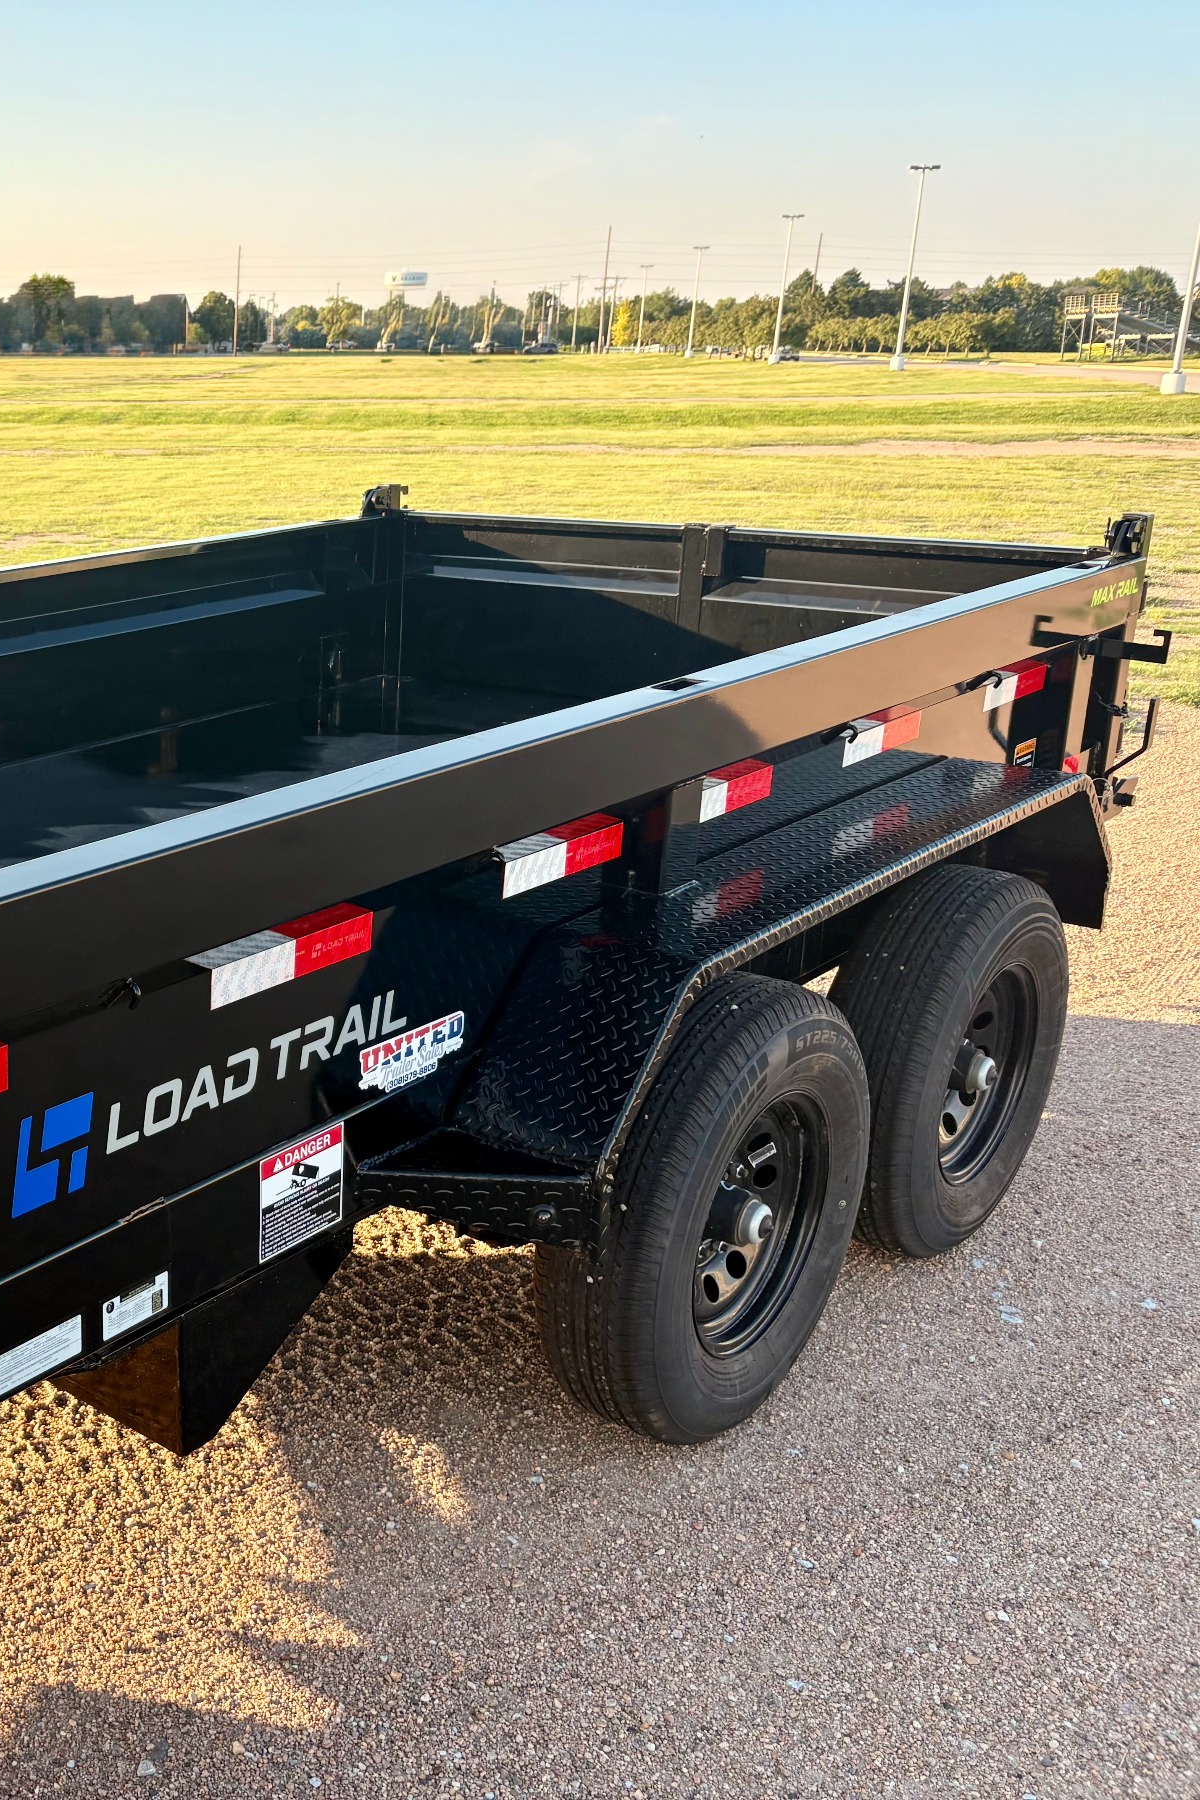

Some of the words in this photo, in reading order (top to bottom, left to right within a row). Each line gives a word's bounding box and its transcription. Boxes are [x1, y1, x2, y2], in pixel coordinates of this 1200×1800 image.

[1090, 583, 1116, 608] MAX
[1115, 576, 1139, 600] RAIL
[322, 936, 344, 952] LOAD
[361, 1013, 463, 1075] UNITED
[380, 1056, 417, 1087] Trailer
[416, 1041, 445, 1068] Sales
[106, 1046, 260, 1155] LOAD
[270, 989, 408, 1081] TRAIL
[284, 1133, 331, 1167] DANGER
